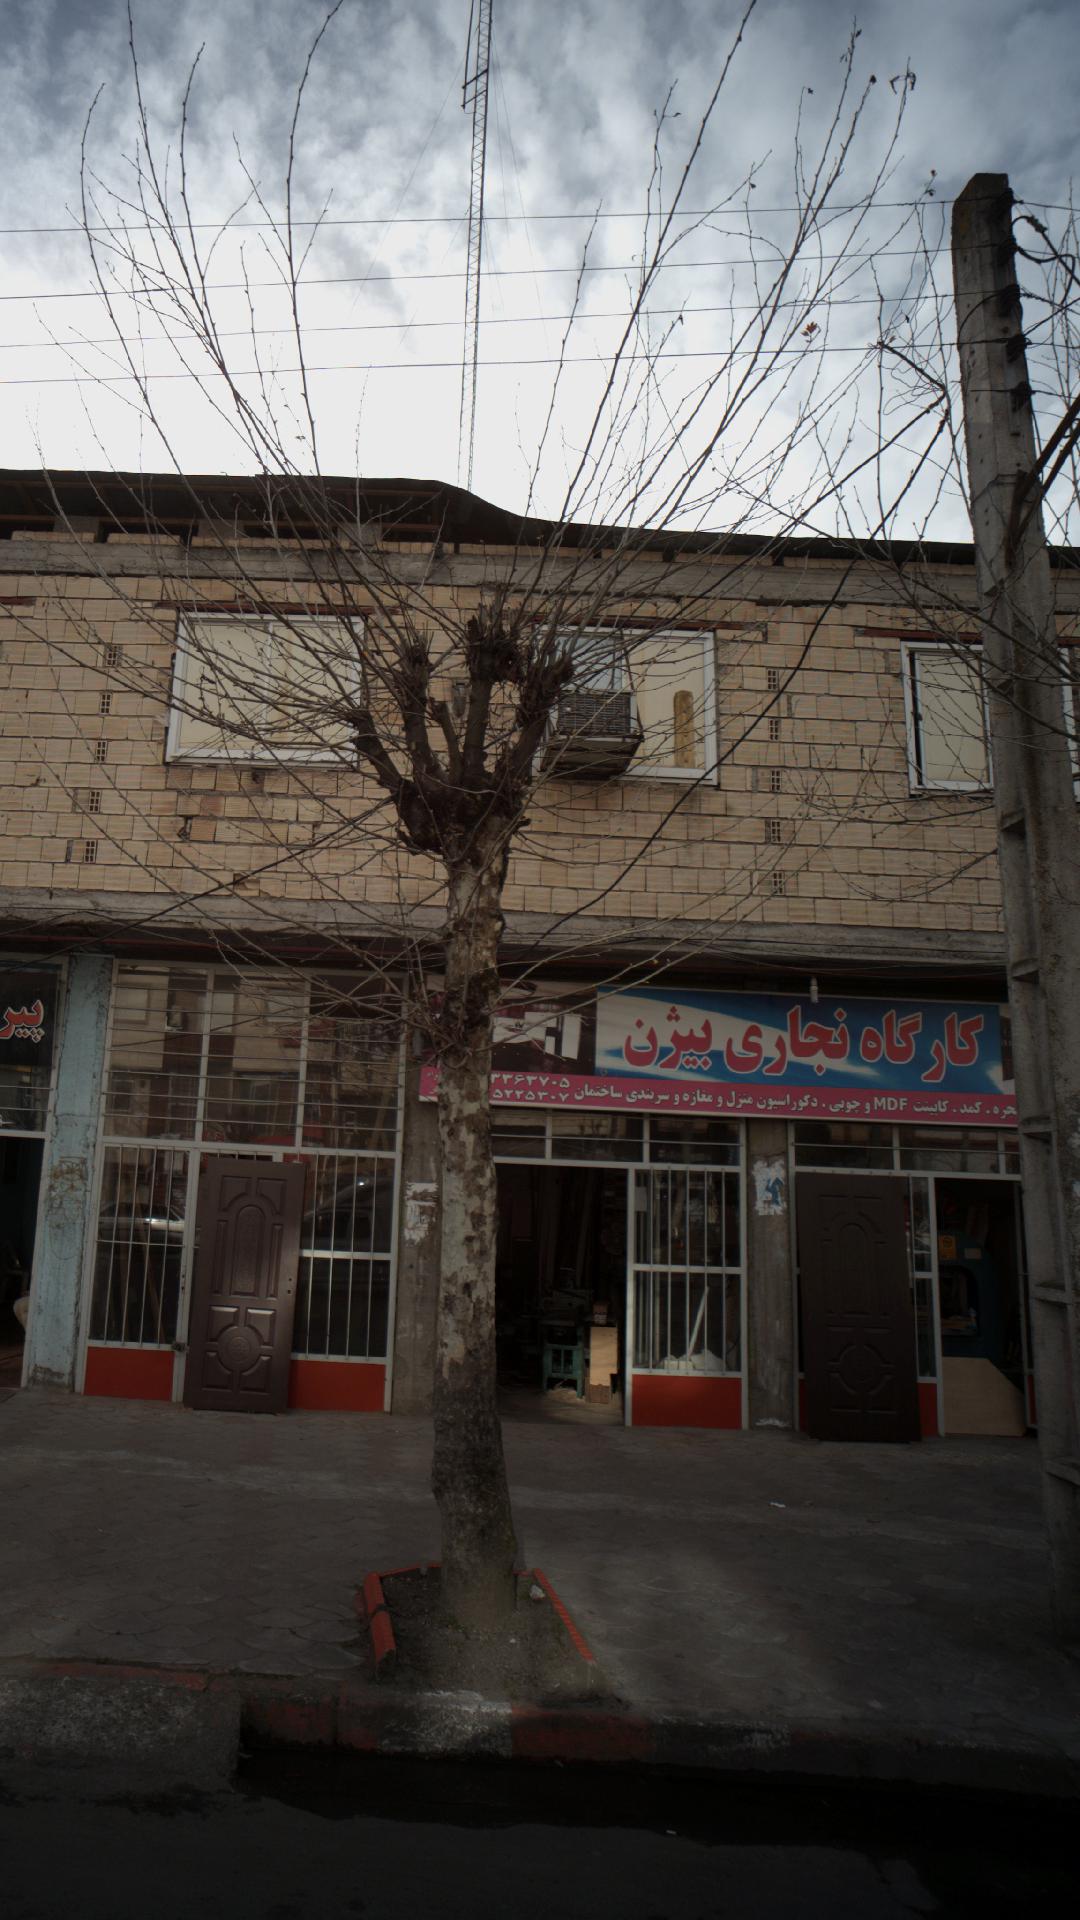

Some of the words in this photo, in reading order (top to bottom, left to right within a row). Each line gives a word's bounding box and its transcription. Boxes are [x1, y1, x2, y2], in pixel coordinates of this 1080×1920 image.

[623, 1005, 713, 1071] بیژن
[723, 1004, 850, 1077] نجاری
[574, 1082, 623, 1100] ساختمان
[673, 1093, 680, 1105] و
[682, 1088, 714, 1106] مغازه
[717, 1095, 723, 1108] و
[726, 1090, 754, 1109] منزل
[828, 1099, 861, 1114] چوبی
[873, 1097, 908, 1111] MDF
[913, 1098, 949, 1116] کابینت
[960, 1101, 982, 1114] کمد
[864, 1102, 871, 1114] و
